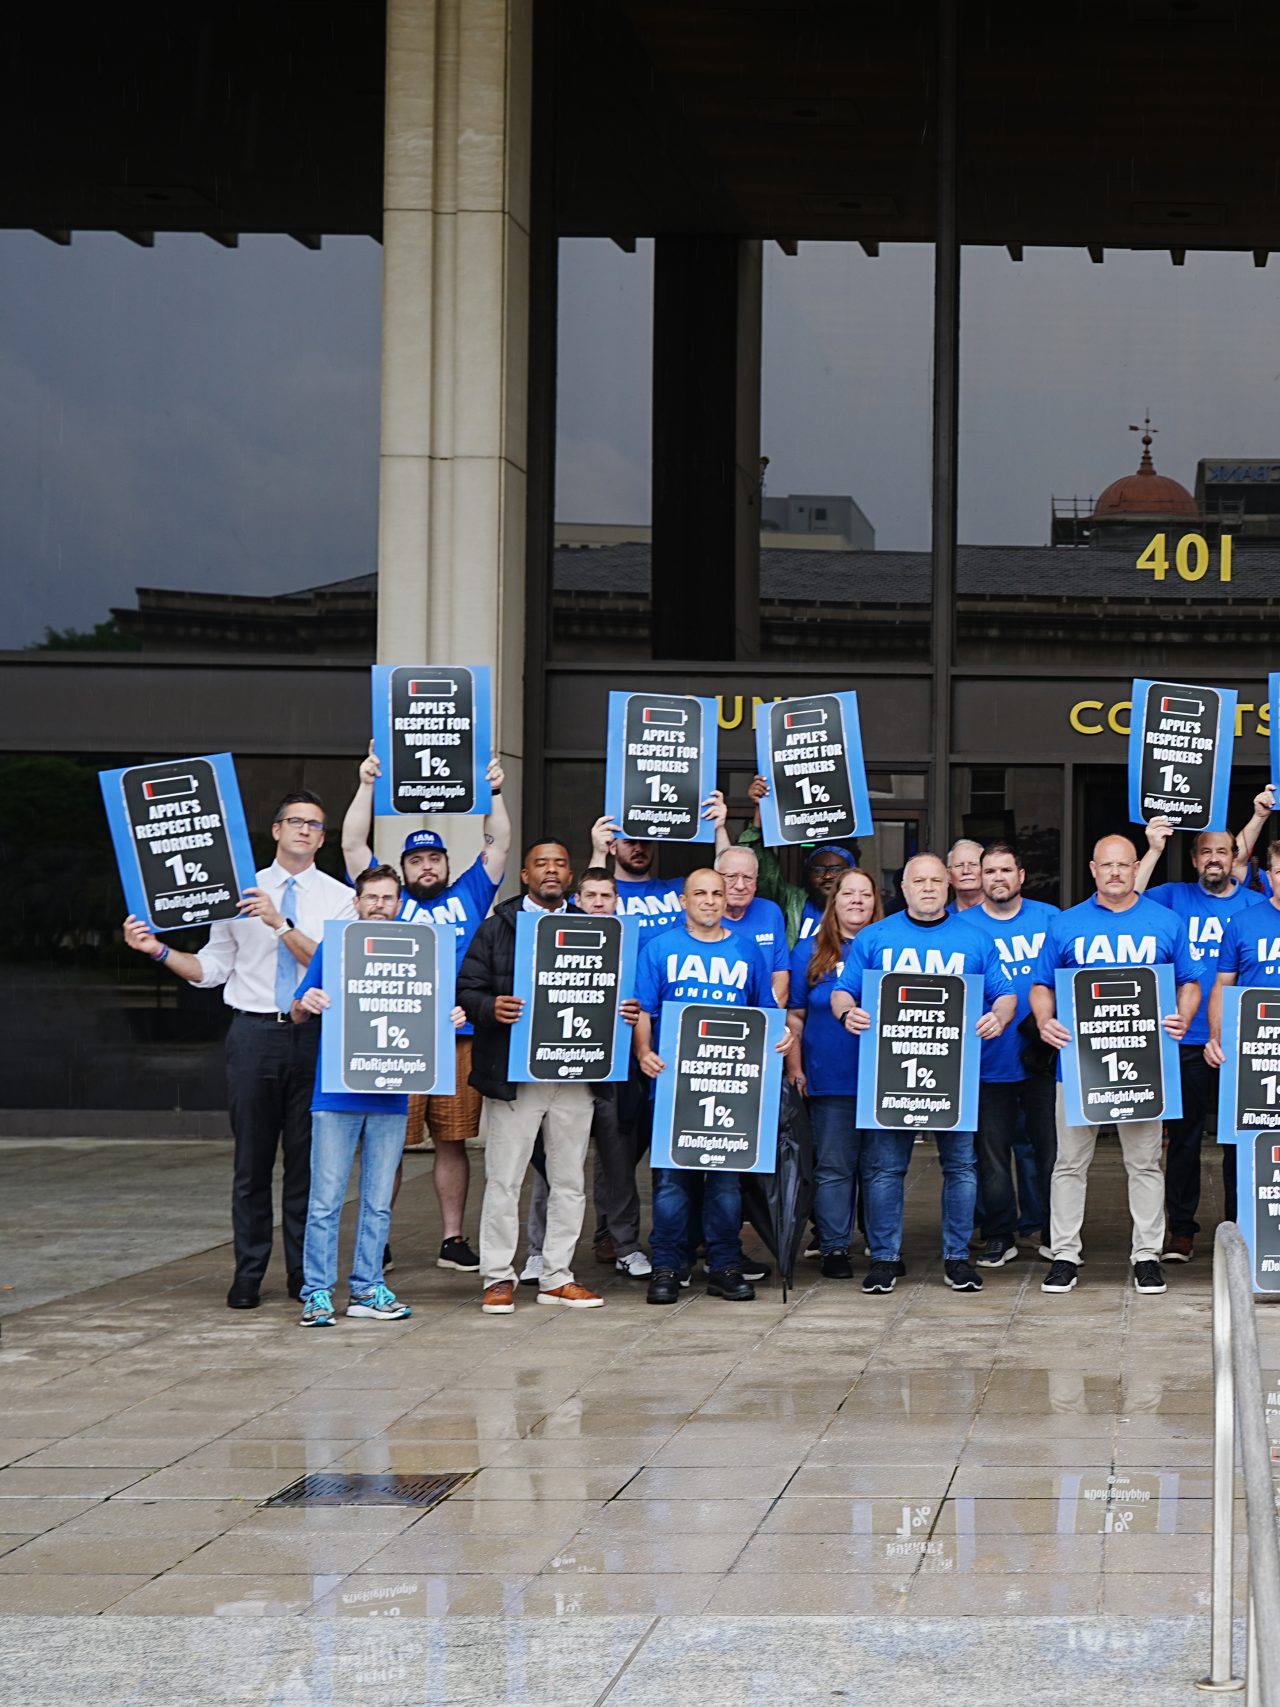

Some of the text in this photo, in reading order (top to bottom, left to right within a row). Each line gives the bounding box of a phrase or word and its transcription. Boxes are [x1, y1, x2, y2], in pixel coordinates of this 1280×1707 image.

[1136, 533, 1232, 581] 401
[409, 702, 455, 714] APPLE'S
[395, 718, 470, 730] RESPECT FOR
[1070, 700, 1270, 736] COTS
[1159, 719, 1201, 734] APPLE'S
[405, 733, 460, 745] WORKERS
[642, 729, 685, 743] APPLE'S
[786, 730, 827, 746] APPLE'S
[1146, 732, 1213, 750] RESPECT FOR
[628, 744, 698, 759] RESPECT FOR
[774, 744, 842, 762] RESPECT FOR
[1153, 748, 1202, 764] WORKERS
[415, 749, 450, 776] 1%
[637, 759, 689, 773] WORKERS
[784, 760, 835, 776] WORKERS
[1160, 765, 1190, 793] 1%
[398, 785, 465, 798] #DoRightApple
[646, 775, 678, 803] 1%
[796, 777, 830, 804] 1%
[150, 799, 201, 819] APPLE'S
[628, 809, 690, 824] #DoRightApple
[784, 809, 846, 826] #DoRightApple
[135, 814, 221, 839] RESPECT FOR
[150, 833, 213, 854] WORKERS
[165, 854, 208, 885] 1%
[155, 889, 230, 911] #DoRightApple
[401, 897, 467, 924] IAM
[1189, 916, 1231, 943] IA
[994, 932, 1046, 963] AM
[1075, 935, 1157, 965] IAM
[555, 955, 602, 969] APPLE'S
[882, 948, 965, 974] IAM
[365, 962, 416, 977] APPLE'S
[667, 954, 748, 989] IAM
[539, 972, 615, 986] RESPECT FOR
[348, 980, 432, 995] RESPECT FOR
[675, 987, 736, 1002] UNION
[548, 990, 604, 1003] WORKERS
[359, 998, 421, 1013] WORKERS
[1094, 1004, 1140, 1017] APPLE'S
[557, 1007, 591, 1038] 1%
[898, 1009, 945, 1023] APPLE'S
[370, 1016, 409, 1048] 1%
[883, 1025, 959, 1039] RESPECT FOR
[1080, 1019, 1155, 1034] RESPECT FOR
[892, 1042, 948, 1055] WORKERS
[1091, 1036, 1147, 1049] WORKERS
[536, 1048, 604, 1062] #DoRightApple
[697, 1044, 745, 1059] APPLE'S
[350, 1058, 426, 1073] #DoRightApple
[681, 1060, 759, 1077] RESPECT FOR
[901, 1058, 936, 1088] 1%
[1102, 1052, 1138, 1081] 1%
[690, 1078, 748, 1094] WORKERS
[882, 1097, 950, 1112] #DoRightApple
[1088, 1089, 1154, 1104] #DoRightApple
[699, 1096, 734, 1127] 1%
[678, 1135, 748, 1152] #DoRightApple
